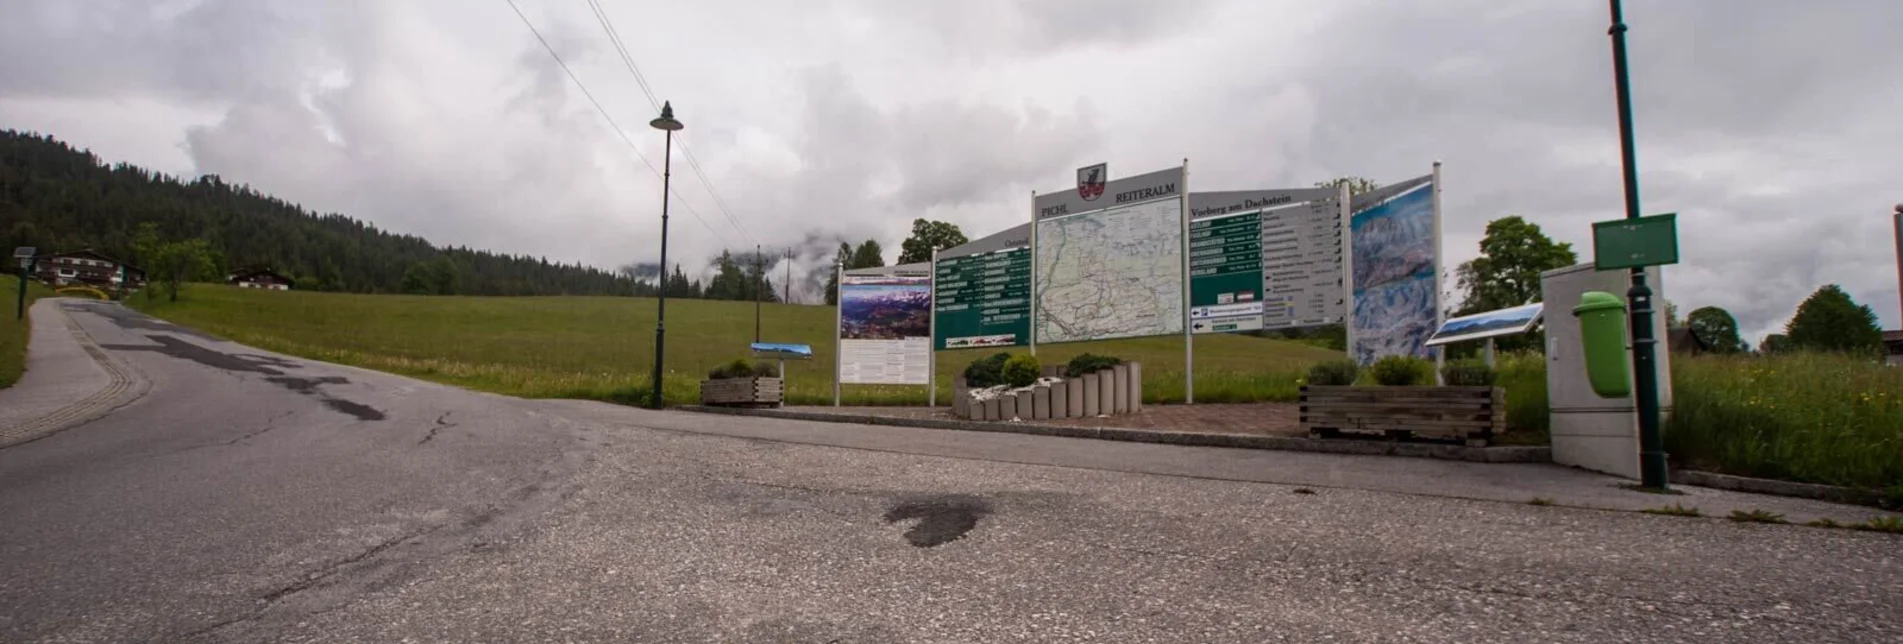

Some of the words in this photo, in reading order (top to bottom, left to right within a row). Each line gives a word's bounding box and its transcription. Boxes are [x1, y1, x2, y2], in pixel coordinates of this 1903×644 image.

[1041, 204, 1069, 217] PICHL
[1115, 183, 1175, 203] REITERALM
[1191, 206, 1227, 218] Vorberg
[1228, 203, 1242, 211] am
[1245, 195, 1292, 210] Dachstein
